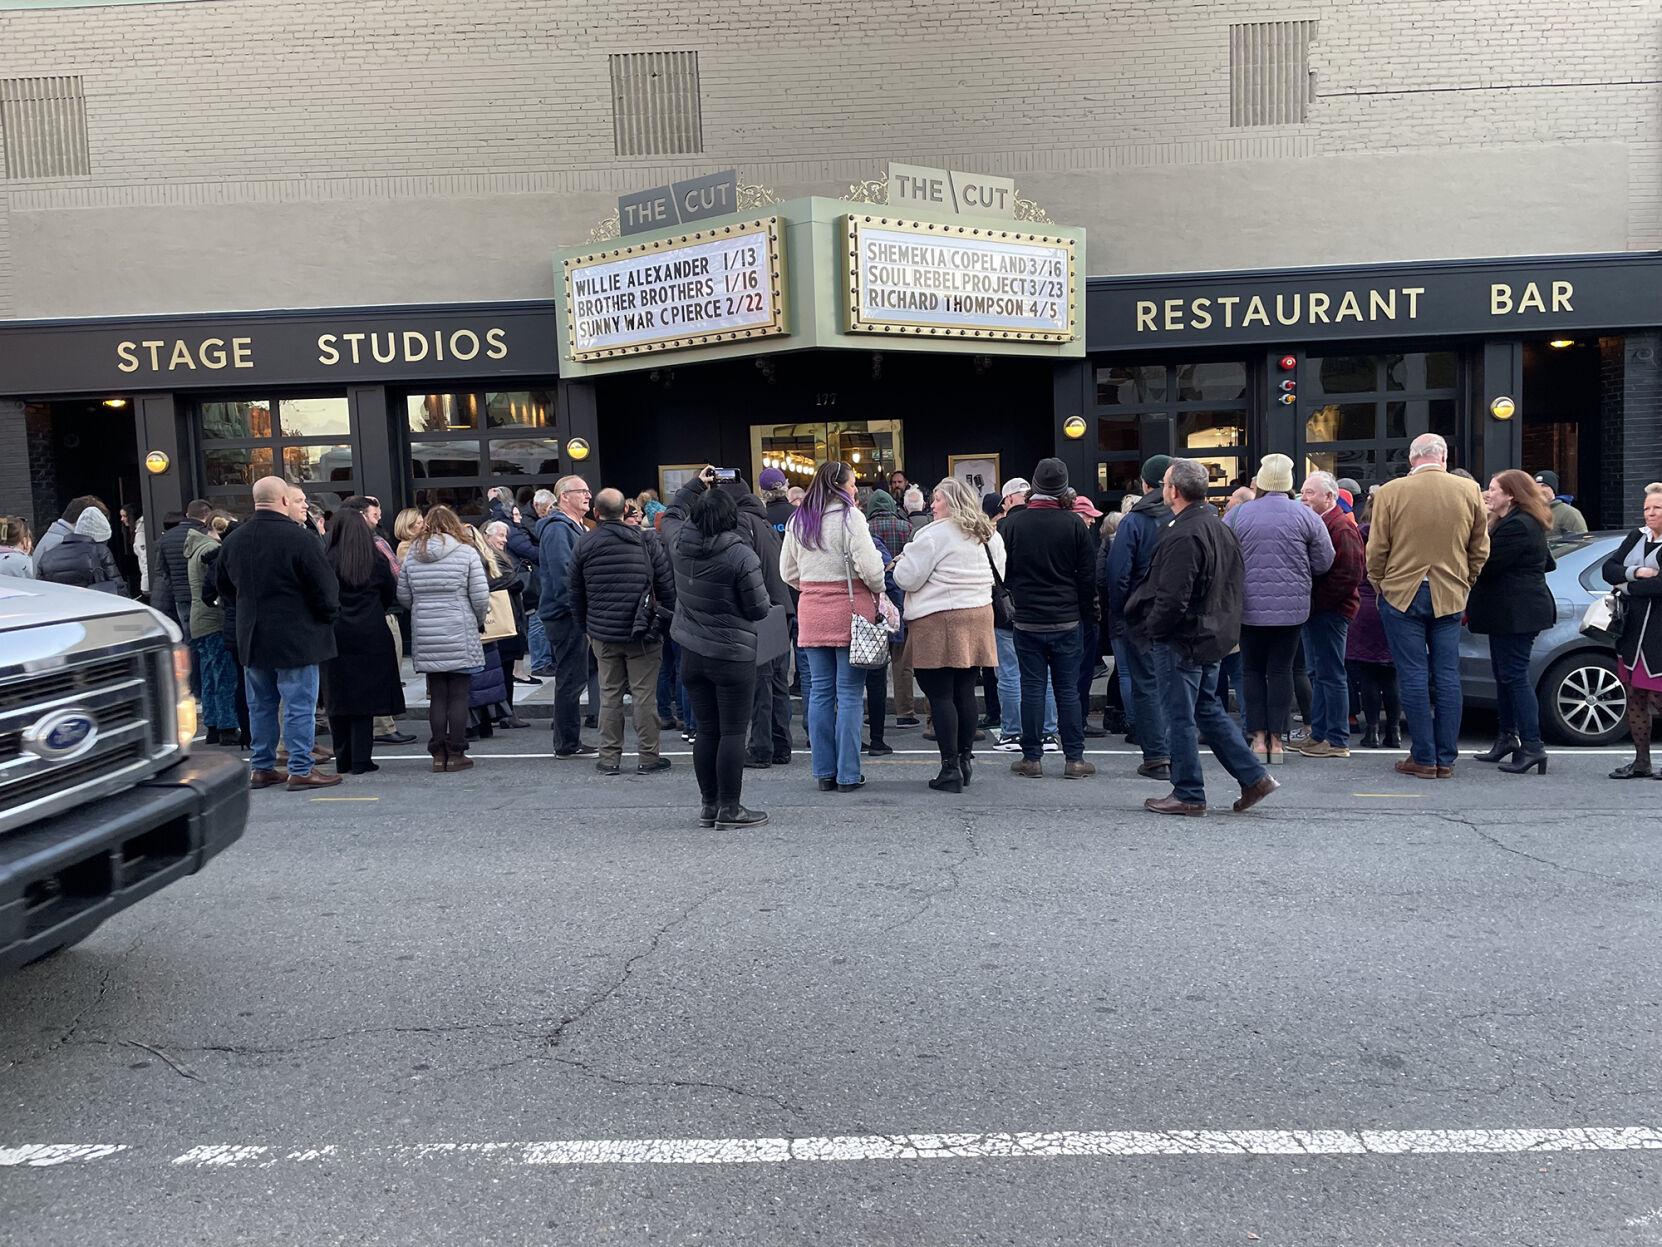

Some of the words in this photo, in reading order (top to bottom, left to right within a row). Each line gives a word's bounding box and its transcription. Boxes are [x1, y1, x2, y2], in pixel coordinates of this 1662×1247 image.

[624, 198, 667, 226] THE
[684, 182, 730, 213] CUT
[895, 174, 942, 202] THE
[962, 184, 1008, 210] CUT
[576, 273, 620, 297] WILLIE
[627, 257, 709, 288] ALEXANDER
[724, 247, 756, 270] 1/13
[867, 242, 947, 267] SHEMEKIA
[951, 250, 1026, 274] COPELAND
[1030, 258, 1062, 277] 3/16
[868, 265, 910, 286] SOUL
[913, 269, 959, 290] REBEL
[962, 273, 1027, 296] PROJECT
[1030, 279, 1063, 298] 3/23
[578, 292, 636, 317] BROTHER
[641, 278, 714, 307] BROTHERS
[725, 270, 758, 292] 1/16
[580, 316, 620, 337] SUNNY
[624, 310, 655, 331] WAR
[726, 292, 763, 316] 2/22
[869, 288, 939, 310] RICHARD
[944, 294, 1023, 316] THOMPSON
[1030, 301, 1057, 318] 4/5
[1136, 287, 1425, 332] RESTAURANT
[1490, 280, 1574, 315] BAR
[116, 337, 254, 373] STAGE
[318, 328, 509, 365] STUDIOS
[816, 392, 838, 406] 177
